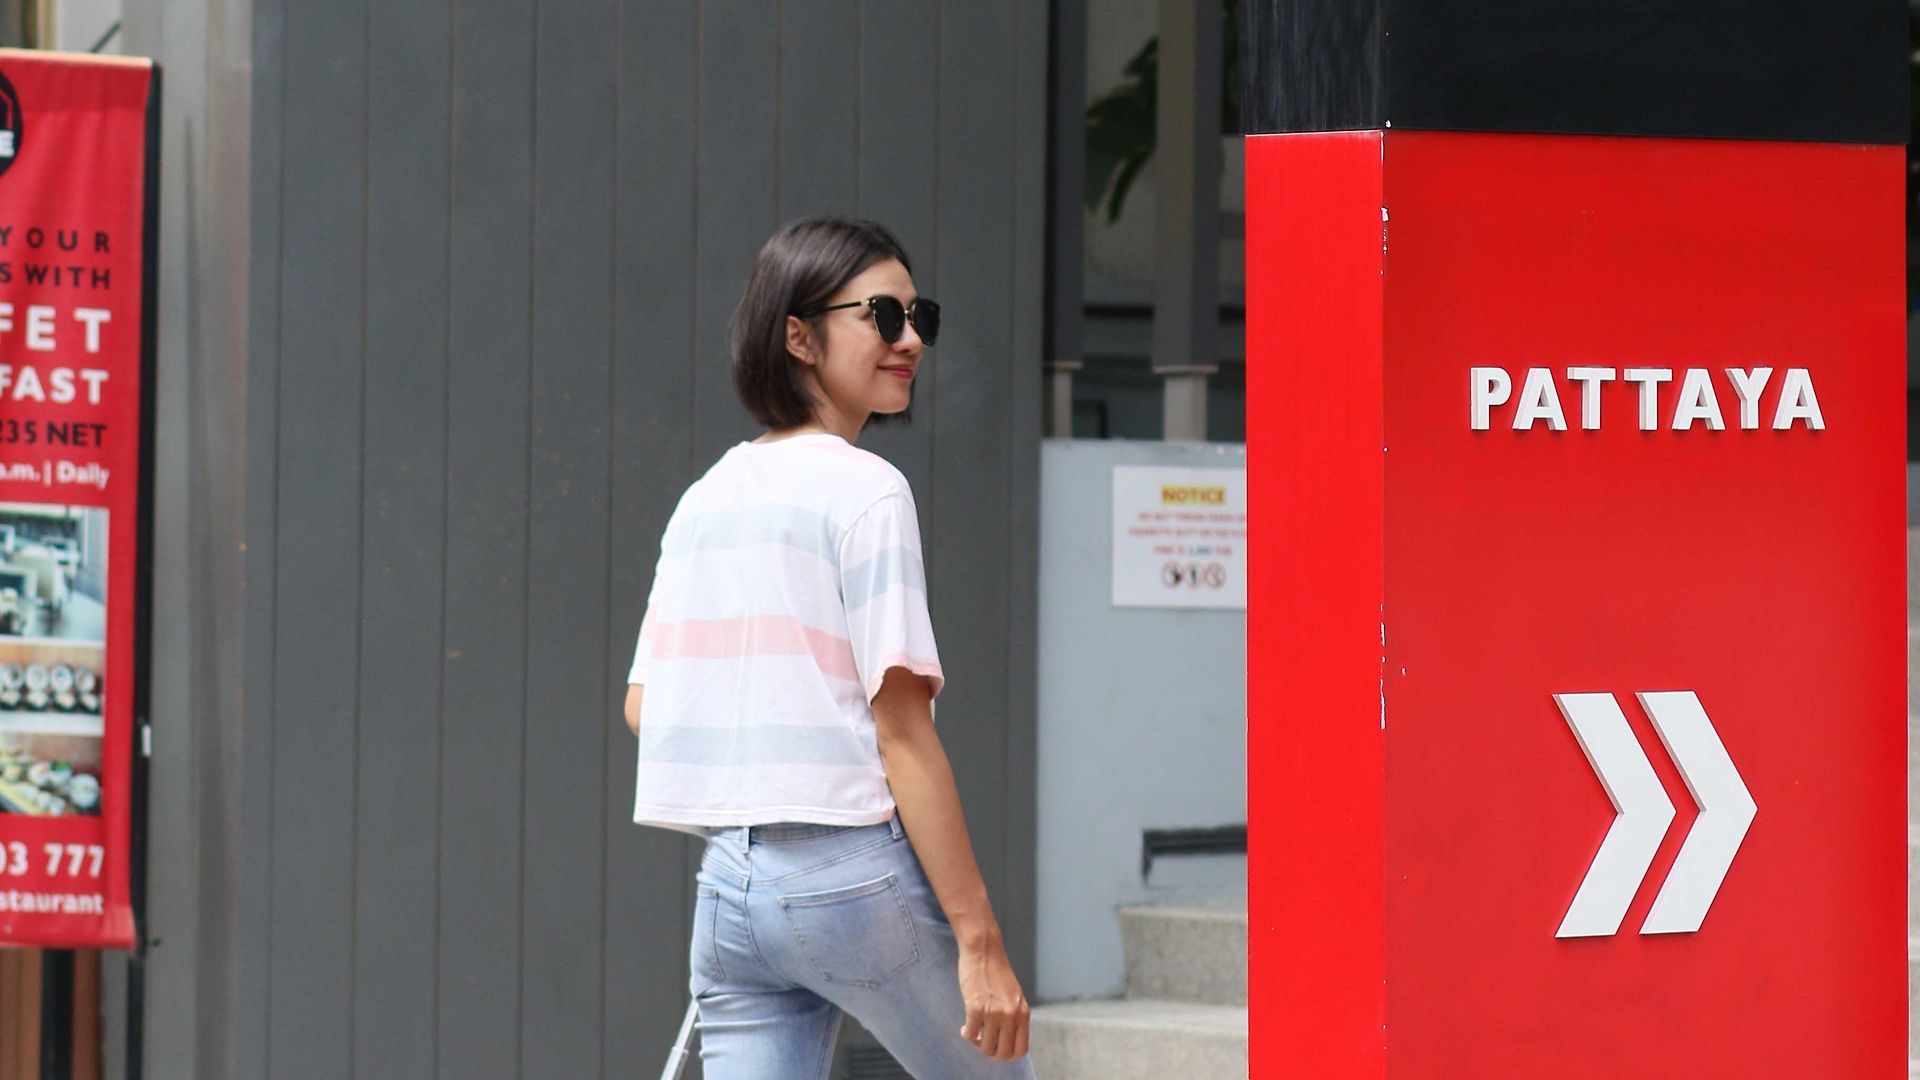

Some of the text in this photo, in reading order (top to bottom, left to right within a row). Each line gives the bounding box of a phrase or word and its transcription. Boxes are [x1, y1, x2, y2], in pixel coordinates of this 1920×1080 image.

[0, 226, 110, 253] YOUR
[24, 264, 110, 290] WITH
[1470, 366, 1826, 431] PATTAYA
[0, 418, 107, 447] 35 NET
[56, 459, 110, 490] Daily
[1162, 486, 1225, 503] NOTICE
[44, 842, 104, 877] 777
[0, 888, 104, 915] staurant
